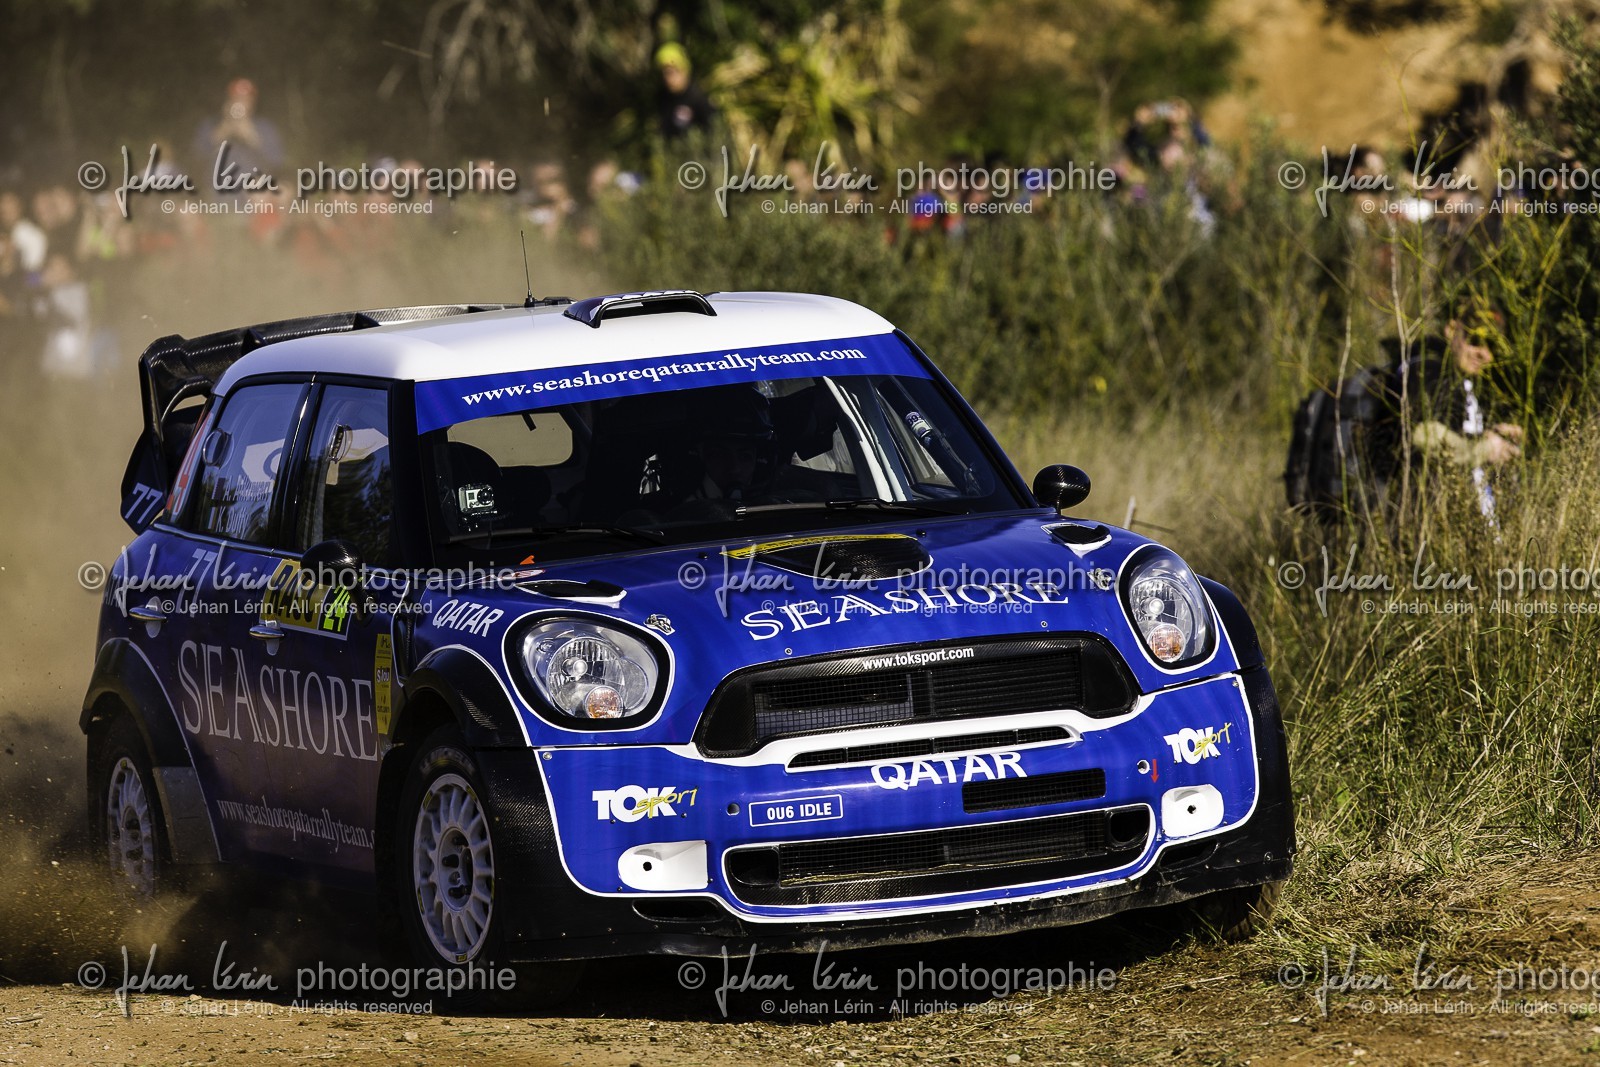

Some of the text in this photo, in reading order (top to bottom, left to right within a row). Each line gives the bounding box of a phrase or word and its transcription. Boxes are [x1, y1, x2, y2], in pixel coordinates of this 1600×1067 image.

[462, 345, 867, 406] www.seashoreqatarrallyteam.com
[125, 482, 163, 524] 77
[175, 548, 218, 618] 77
[432, 599, 504, 637] QATAR
[741, 582, 1068, 640] SEASHORE
[862, 646, 974, 670] www.toksport.com
[178, 640, 378, 761] SEASHORE
[870, 752, 1028, 790] QATAR
[800, 803, 832, 818] IDLE
